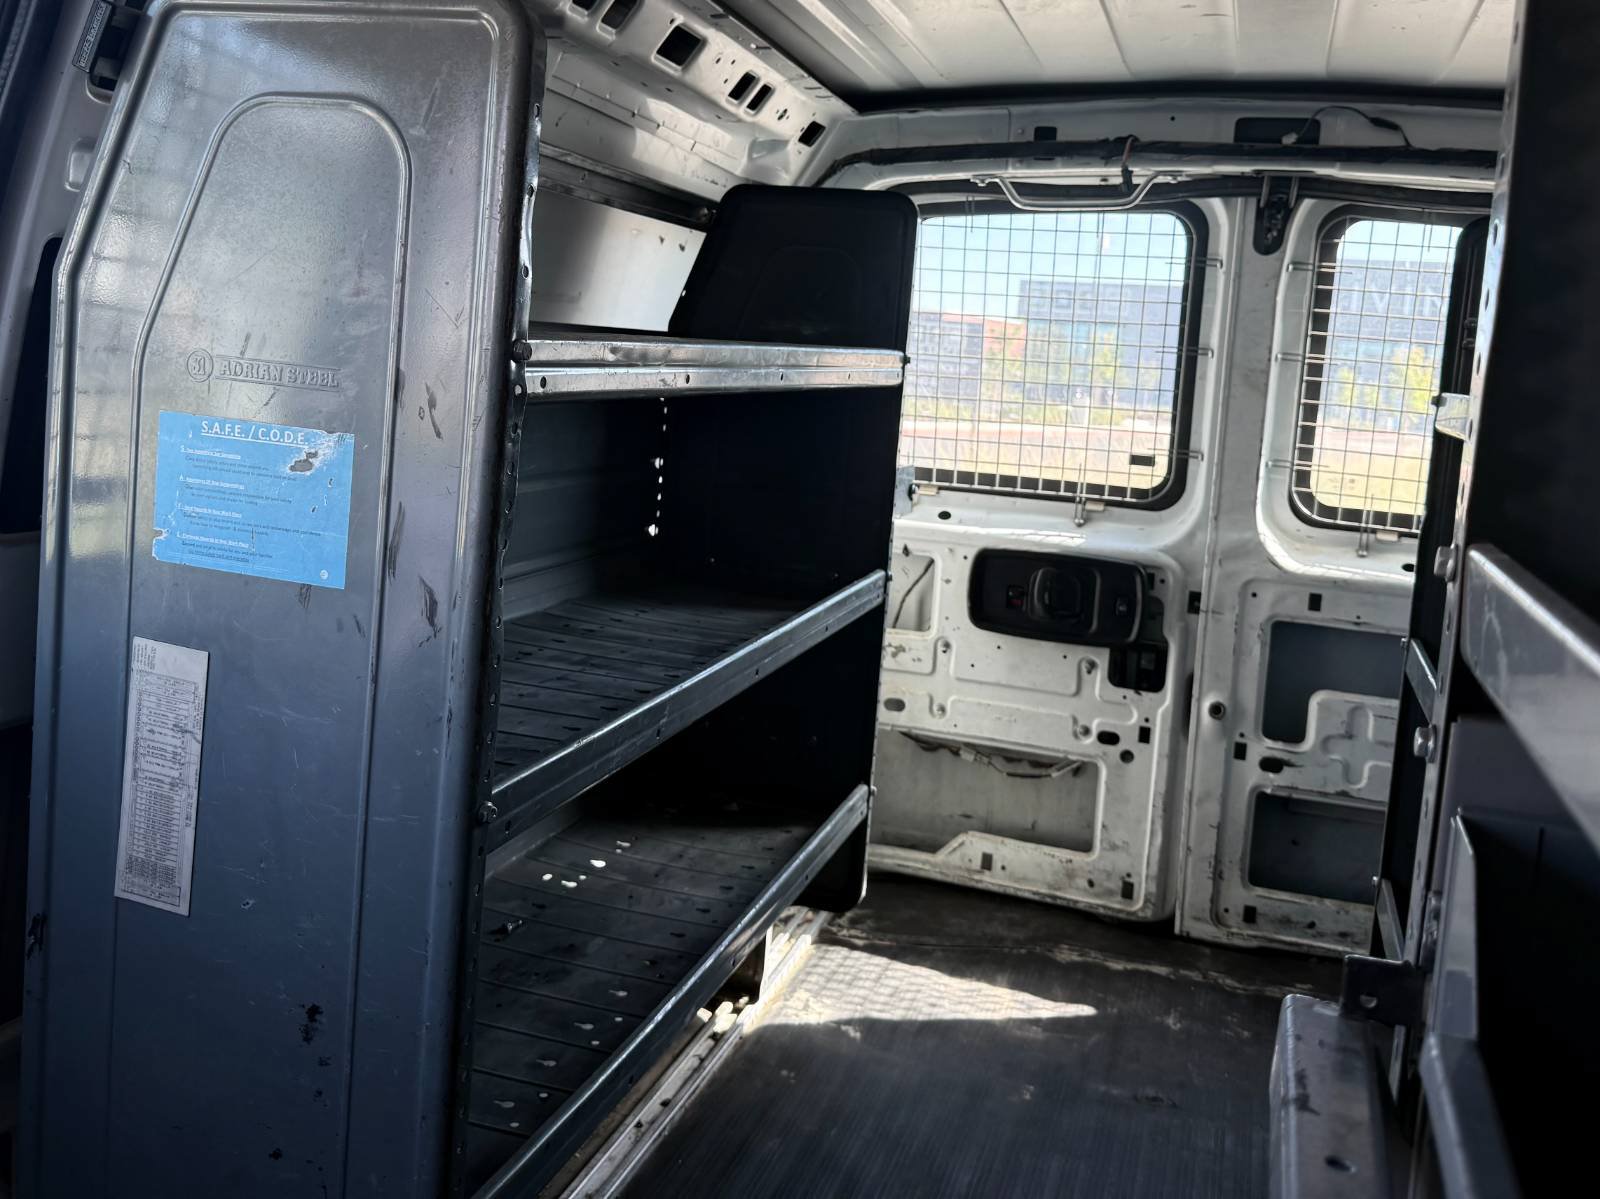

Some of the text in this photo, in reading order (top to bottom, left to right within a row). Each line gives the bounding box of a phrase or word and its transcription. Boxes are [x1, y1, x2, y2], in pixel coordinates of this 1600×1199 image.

[219, 359, 284, 383] ADRIAN
[287, 366, 340, 388] STEEL
[201, 420, 245, 438] S.A.F.E.
[258, 427, 309, 445] C.O.D.E.
